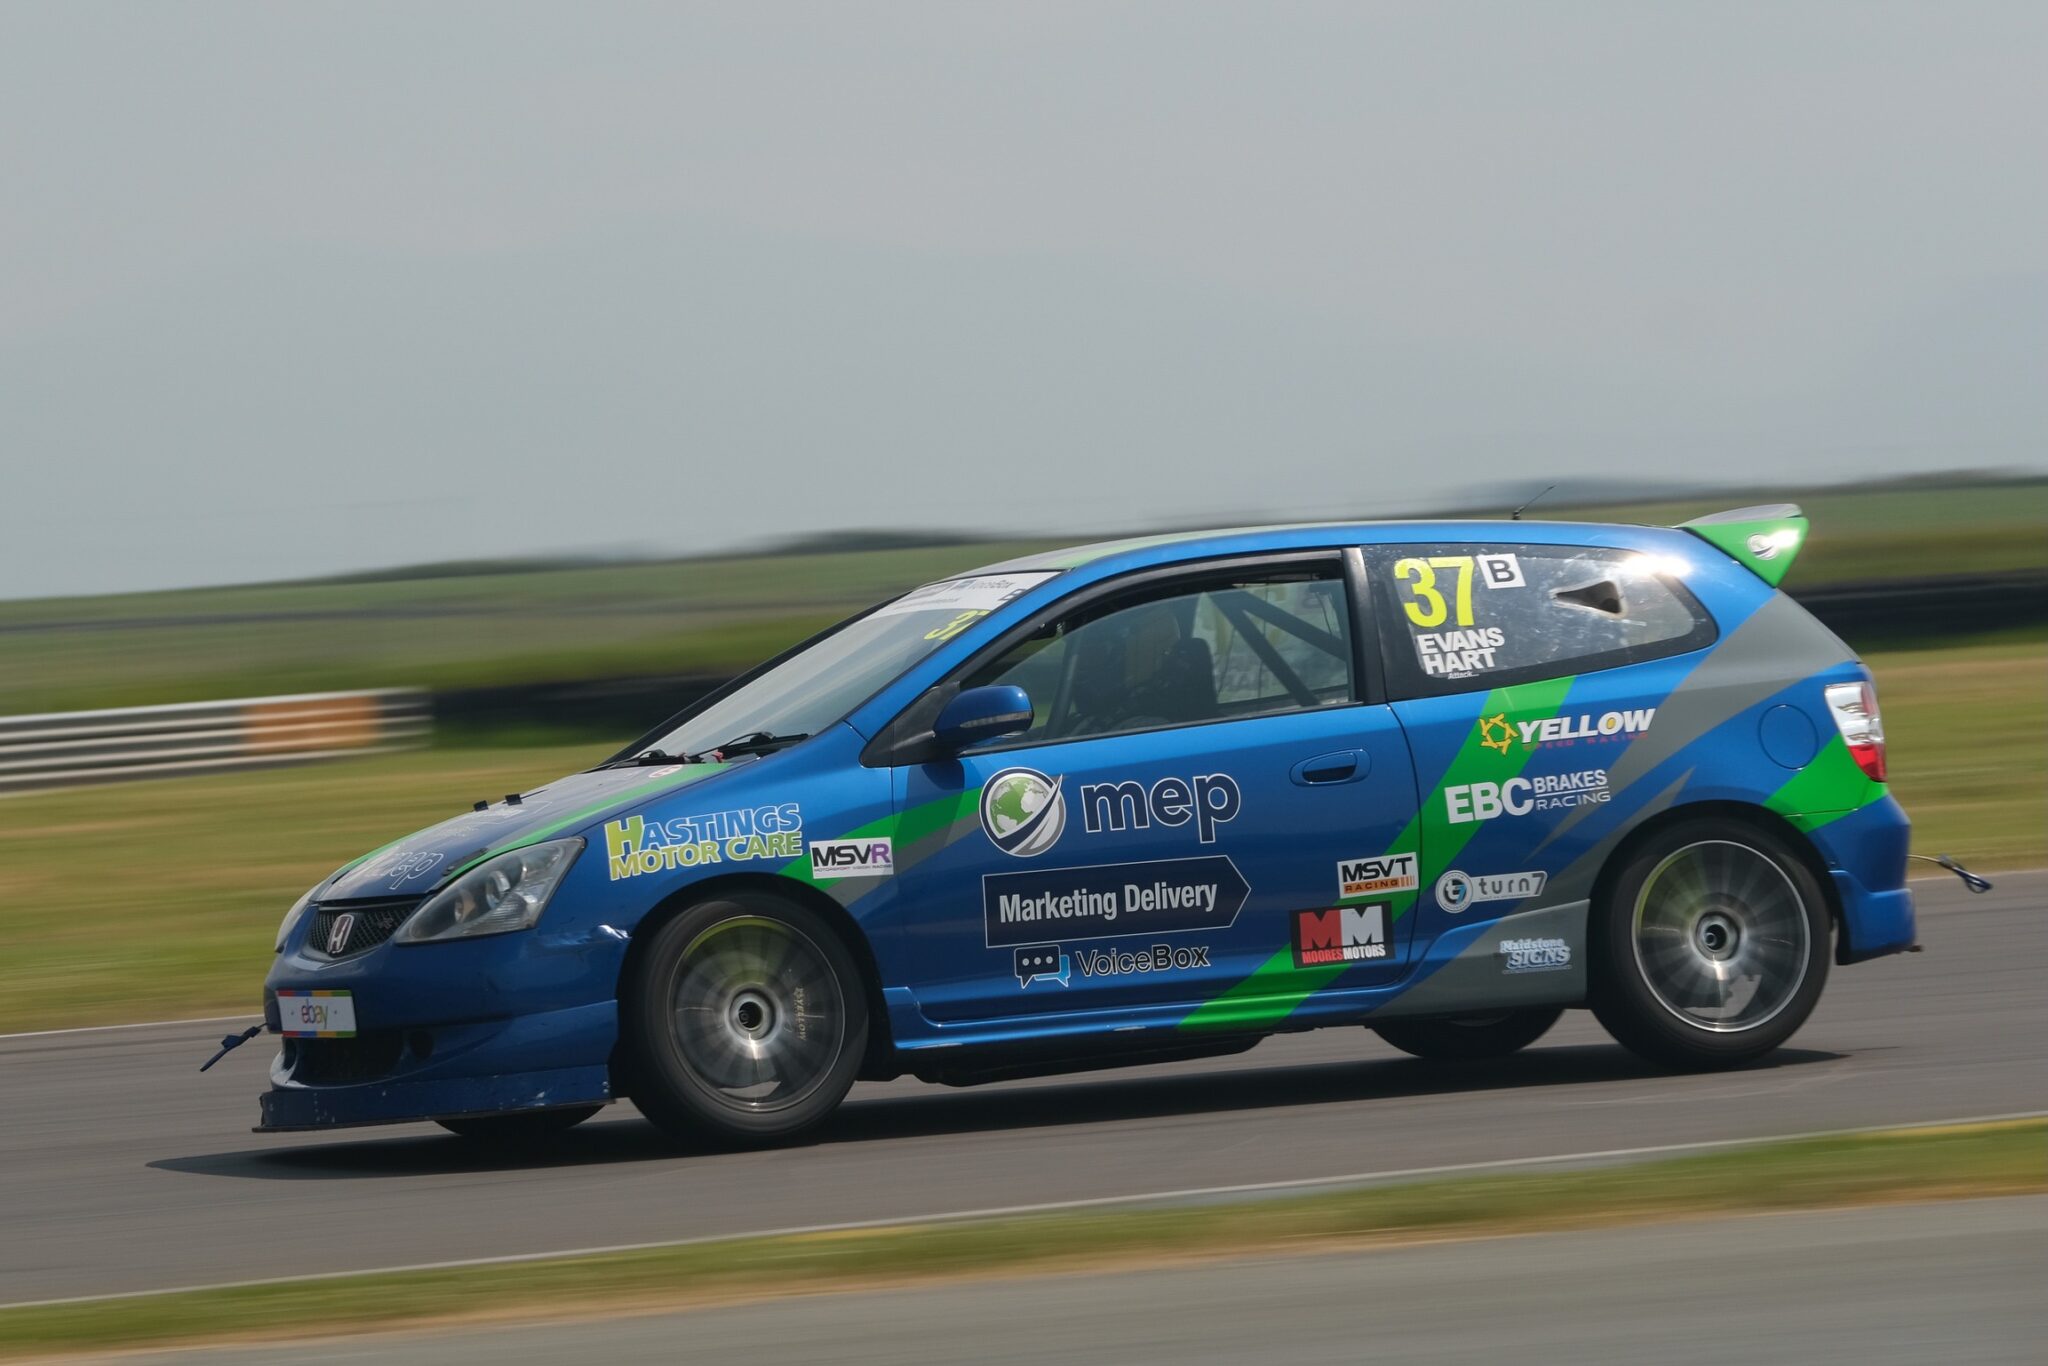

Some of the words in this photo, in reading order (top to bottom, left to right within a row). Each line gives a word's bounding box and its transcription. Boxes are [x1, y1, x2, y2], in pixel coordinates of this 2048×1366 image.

[1486, 559, 1516, 583] B
[1394, 556, 1475, 627] 37
[1416, 627, 1505, 654] EVANS
[1422, 647, 1496, 675] HART
[1517, 708, 1656, 743] YELLOW
[1534, 769, 1608, 793] BRAKES
[1081, 773, 1241, 843] mep
[1444, 777, 1534, 824] EBC
[1536, 791, 1611, 810] RACING
[604, 803, 802, 858] HASTINGS
[609, 841, 722, 881] MOTOR
[726, 832, 803, 861] CARE
[812, 843, 891, 867] MSVR
[1342, 856, 1413, 882] MSVT
[1344, 878, 1399, 892] RACING
[1479, 873, 1545, 896] turn7
[999, 888, 1117, 923] Marketing
[1124, 882, 1217, 913] Delivery
[1076, 944, 1211, 976] VoiceBox
[1302, 949, 1343, 964] MOORES
[1343, 944, 1386, 960] MOTORS
[1507, 945, 1571, 968] SIGNS
[301, 998, 328, 1029] ebay
